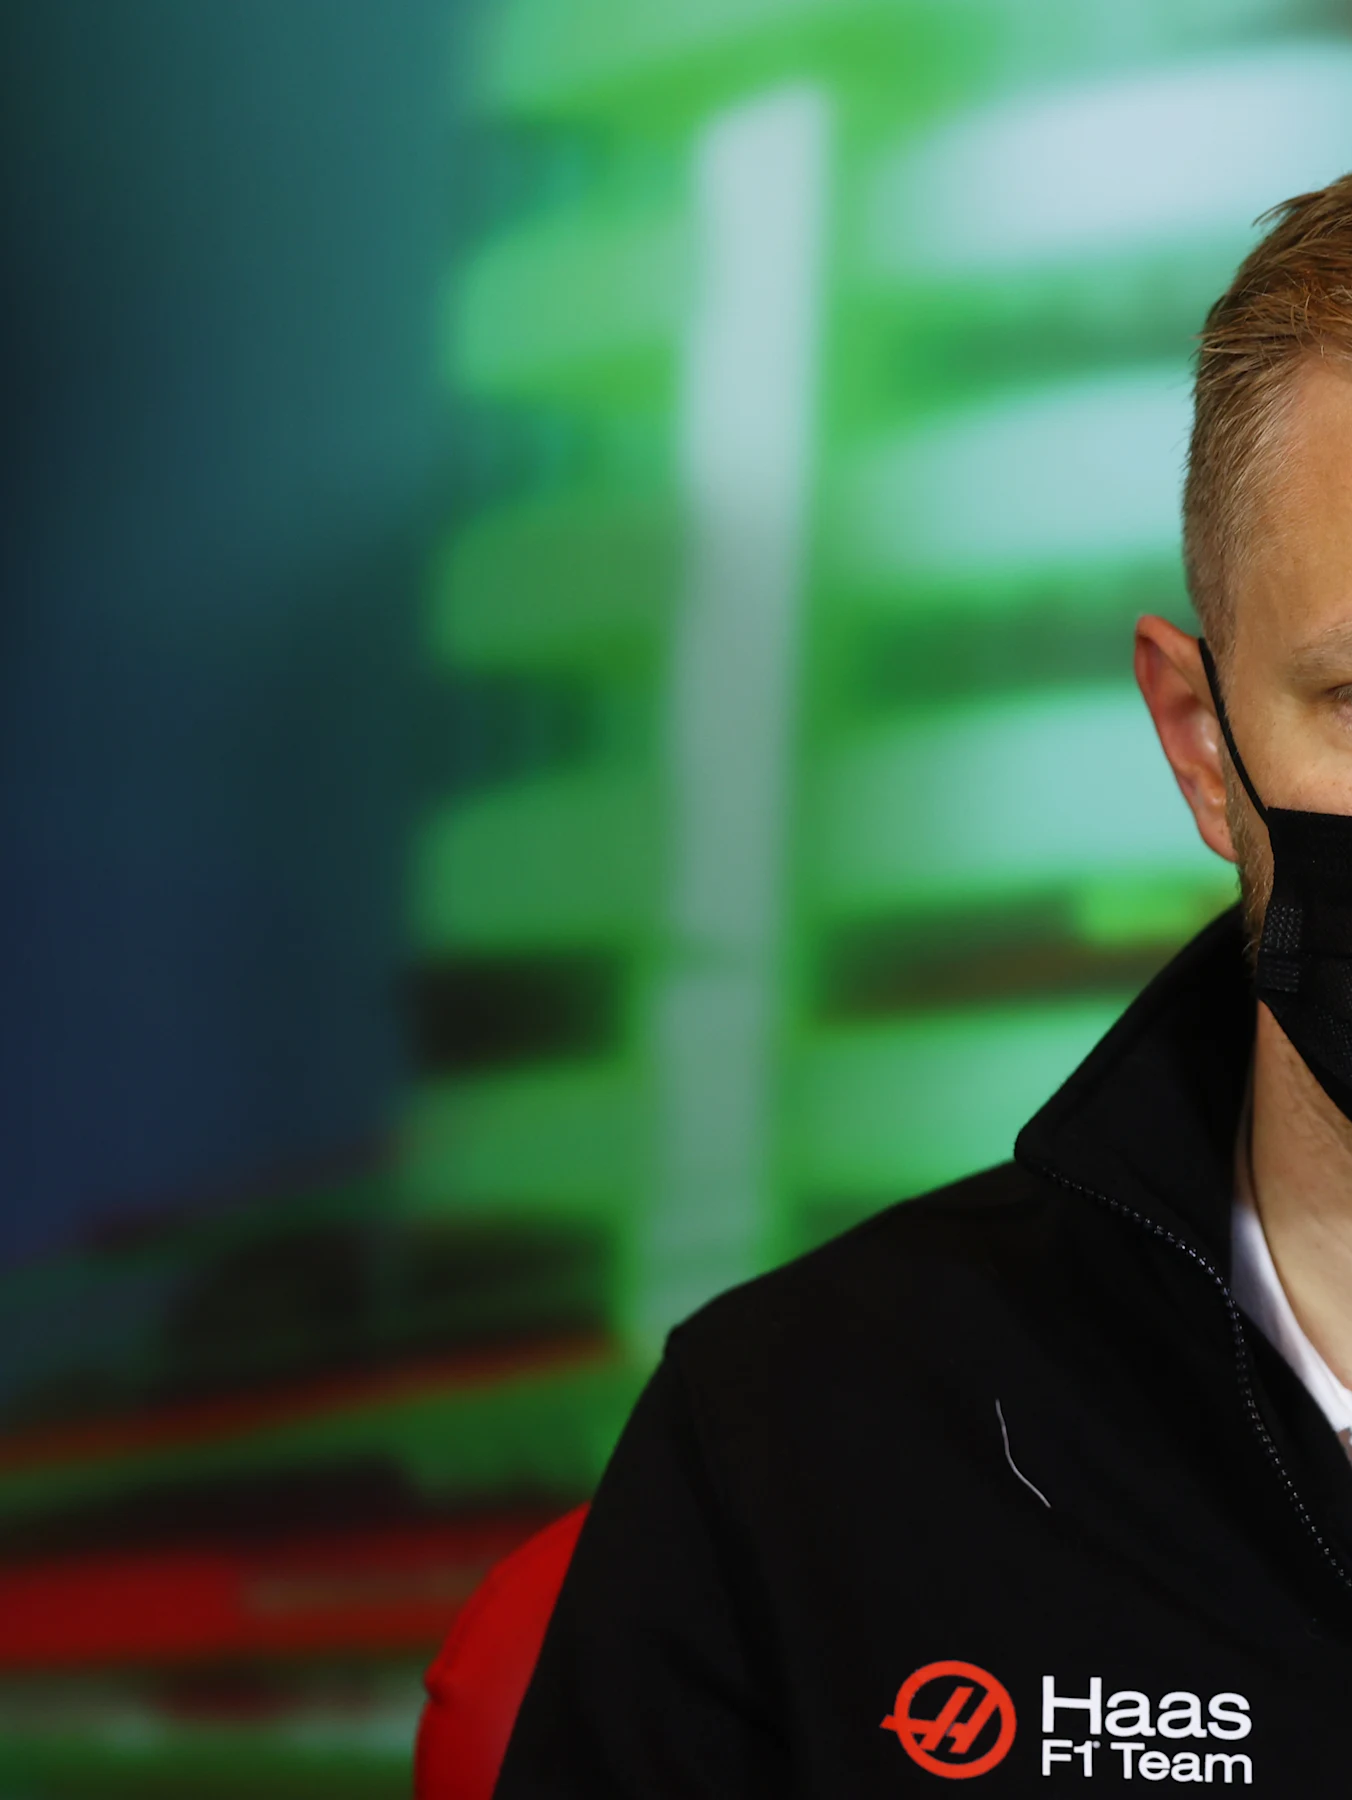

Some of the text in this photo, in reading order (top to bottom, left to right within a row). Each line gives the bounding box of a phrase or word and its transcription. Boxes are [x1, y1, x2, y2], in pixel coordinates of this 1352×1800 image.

[1042, 1675, 1252, 1741] Haas
[1041, 1738, 1253, 1785] F1 Team
